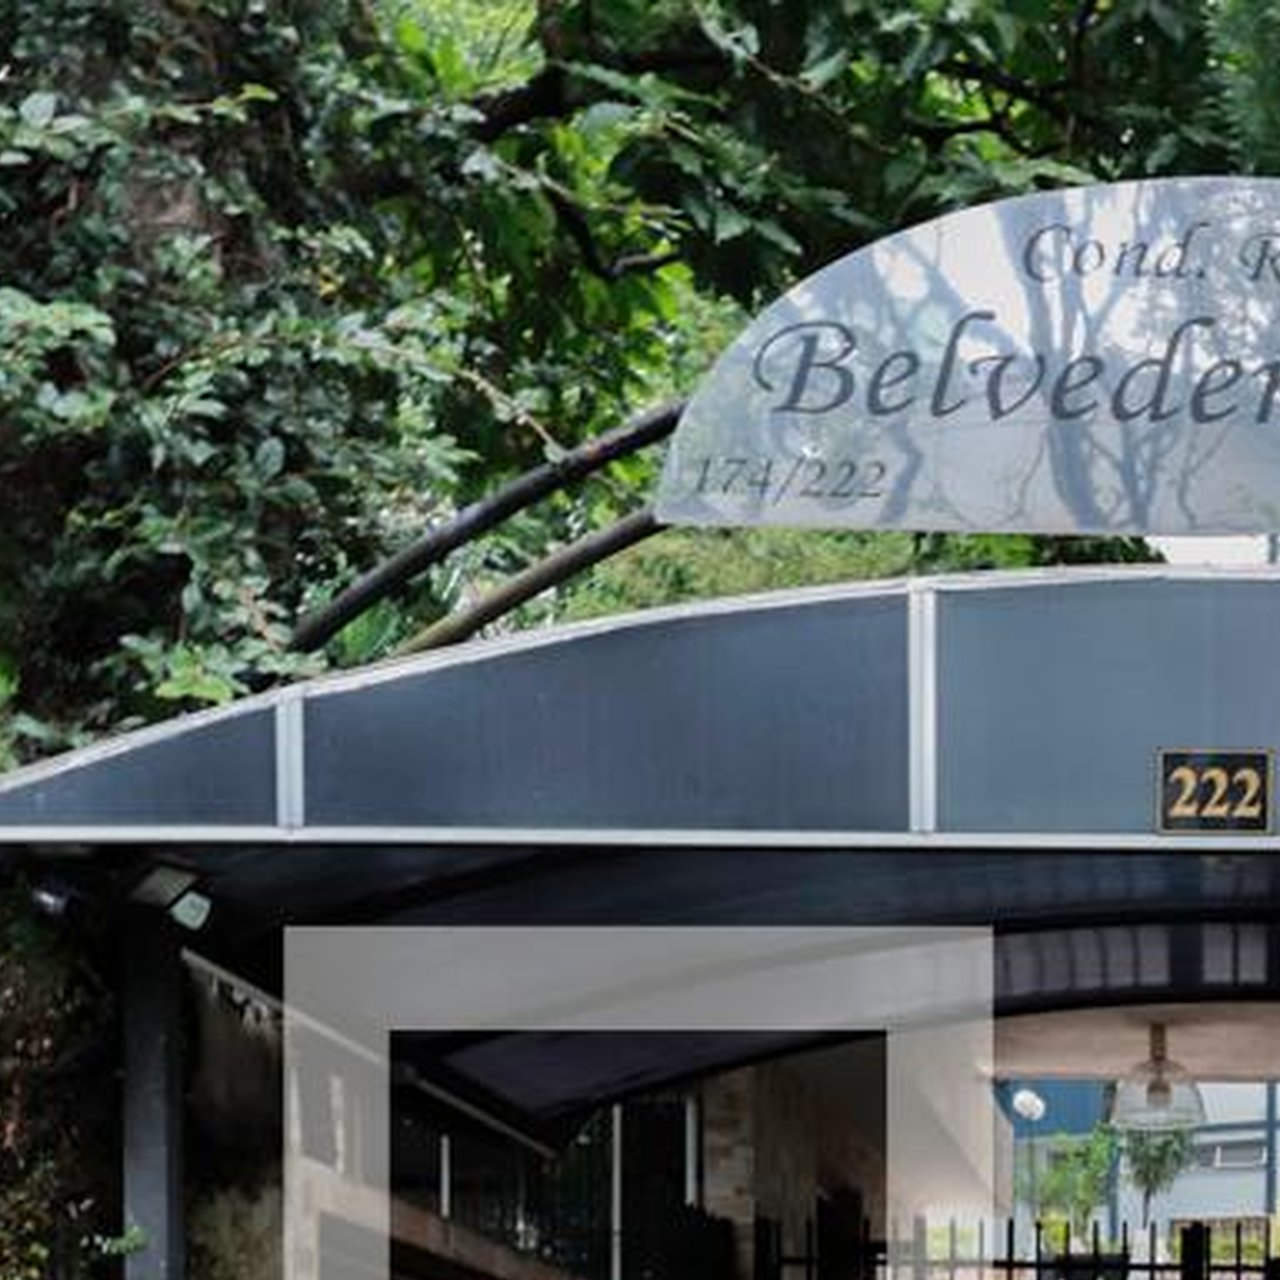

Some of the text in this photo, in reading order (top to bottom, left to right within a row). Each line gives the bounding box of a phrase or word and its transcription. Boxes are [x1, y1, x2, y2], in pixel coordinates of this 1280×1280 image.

[1023, 221, 1208, 284] Cond.
[694, 456, 888, 506] 174/222
[1169, 766, 1262, 817] 222
